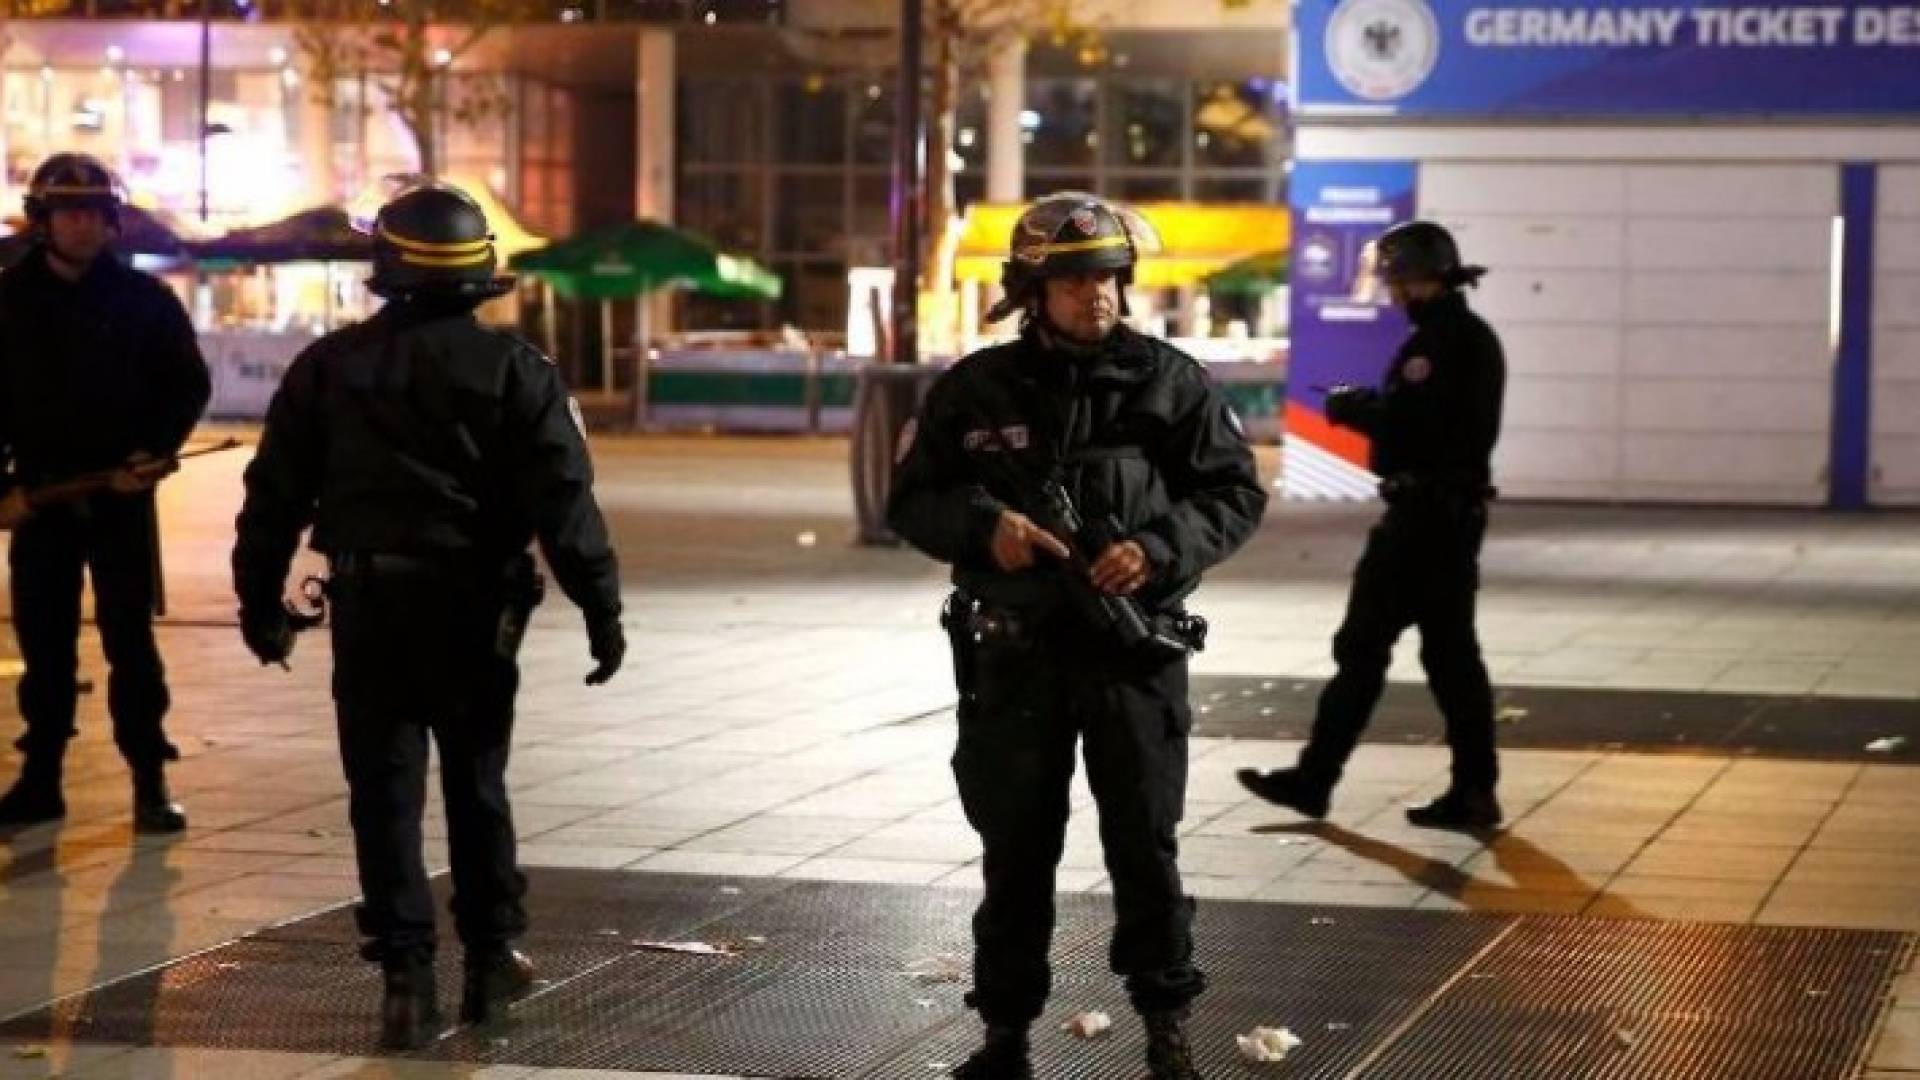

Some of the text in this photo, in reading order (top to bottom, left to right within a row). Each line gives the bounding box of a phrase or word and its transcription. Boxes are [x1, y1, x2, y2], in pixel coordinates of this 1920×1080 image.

[1466, 8, 1920, 45] GERMANY TICKET DE
